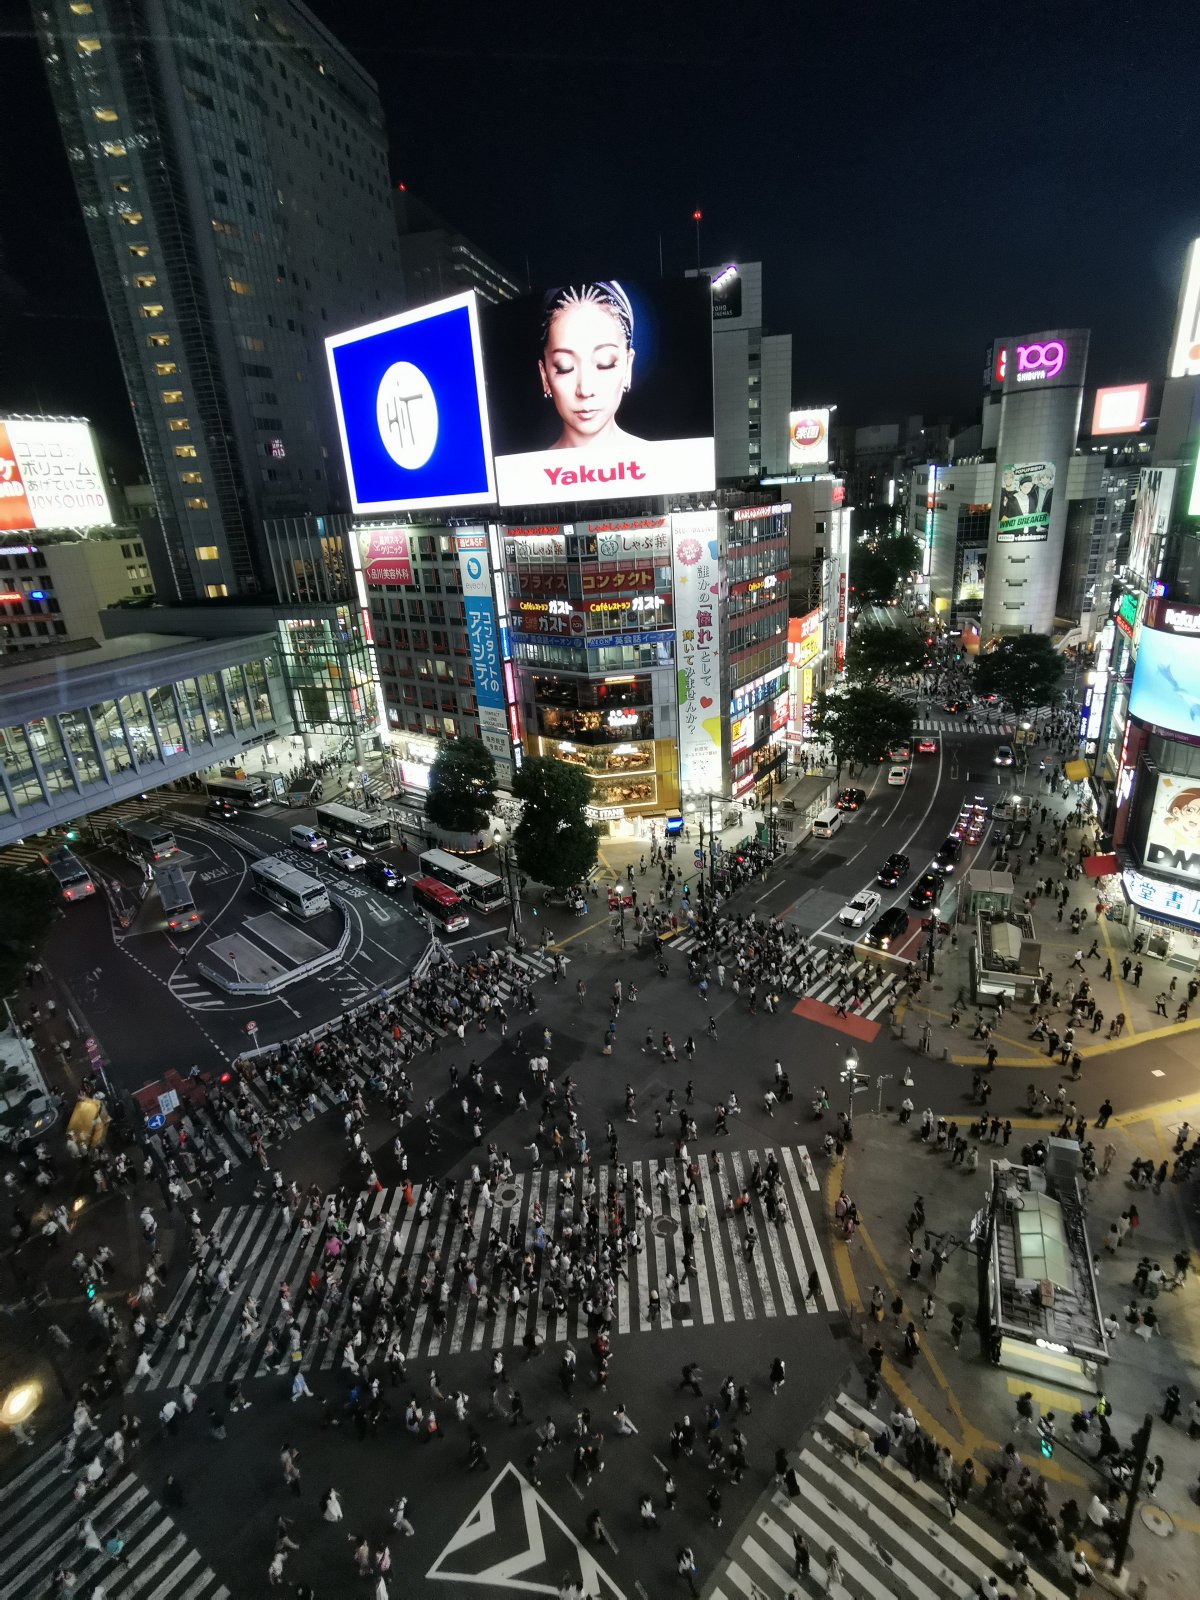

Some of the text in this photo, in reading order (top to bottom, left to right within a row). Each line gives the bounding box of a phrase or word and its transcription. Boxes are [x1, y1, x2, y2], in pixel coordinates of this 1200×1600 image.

[1016, 342, 1064, 378] 109
[1016, 370, 1046, 382] SHIBUYA
[543, 461, 646, 487] Yakult
[32, 494, 104, 508] JOYSOUND
[1017, 513, 1048, 526] BREAKER
[505, 545, 515, 555] 9F
[623, 533, 667, 551] しゃぶ葉
[371, 568, 409, 580] 品川美容外科
[582, 571, 652, 589] コンタクト
[549, 599, 574, 615] ガスト
[632, 595, 665, 611] ガスト
[512, 616, 523, 626] 7F
[539, 615, 568, 633] ガスト
[614, 632, 674, 645] 英会話イーオン
[469, 611, 489, 691] アイシティ
[482, 612, 500, 693] コンタクトの
